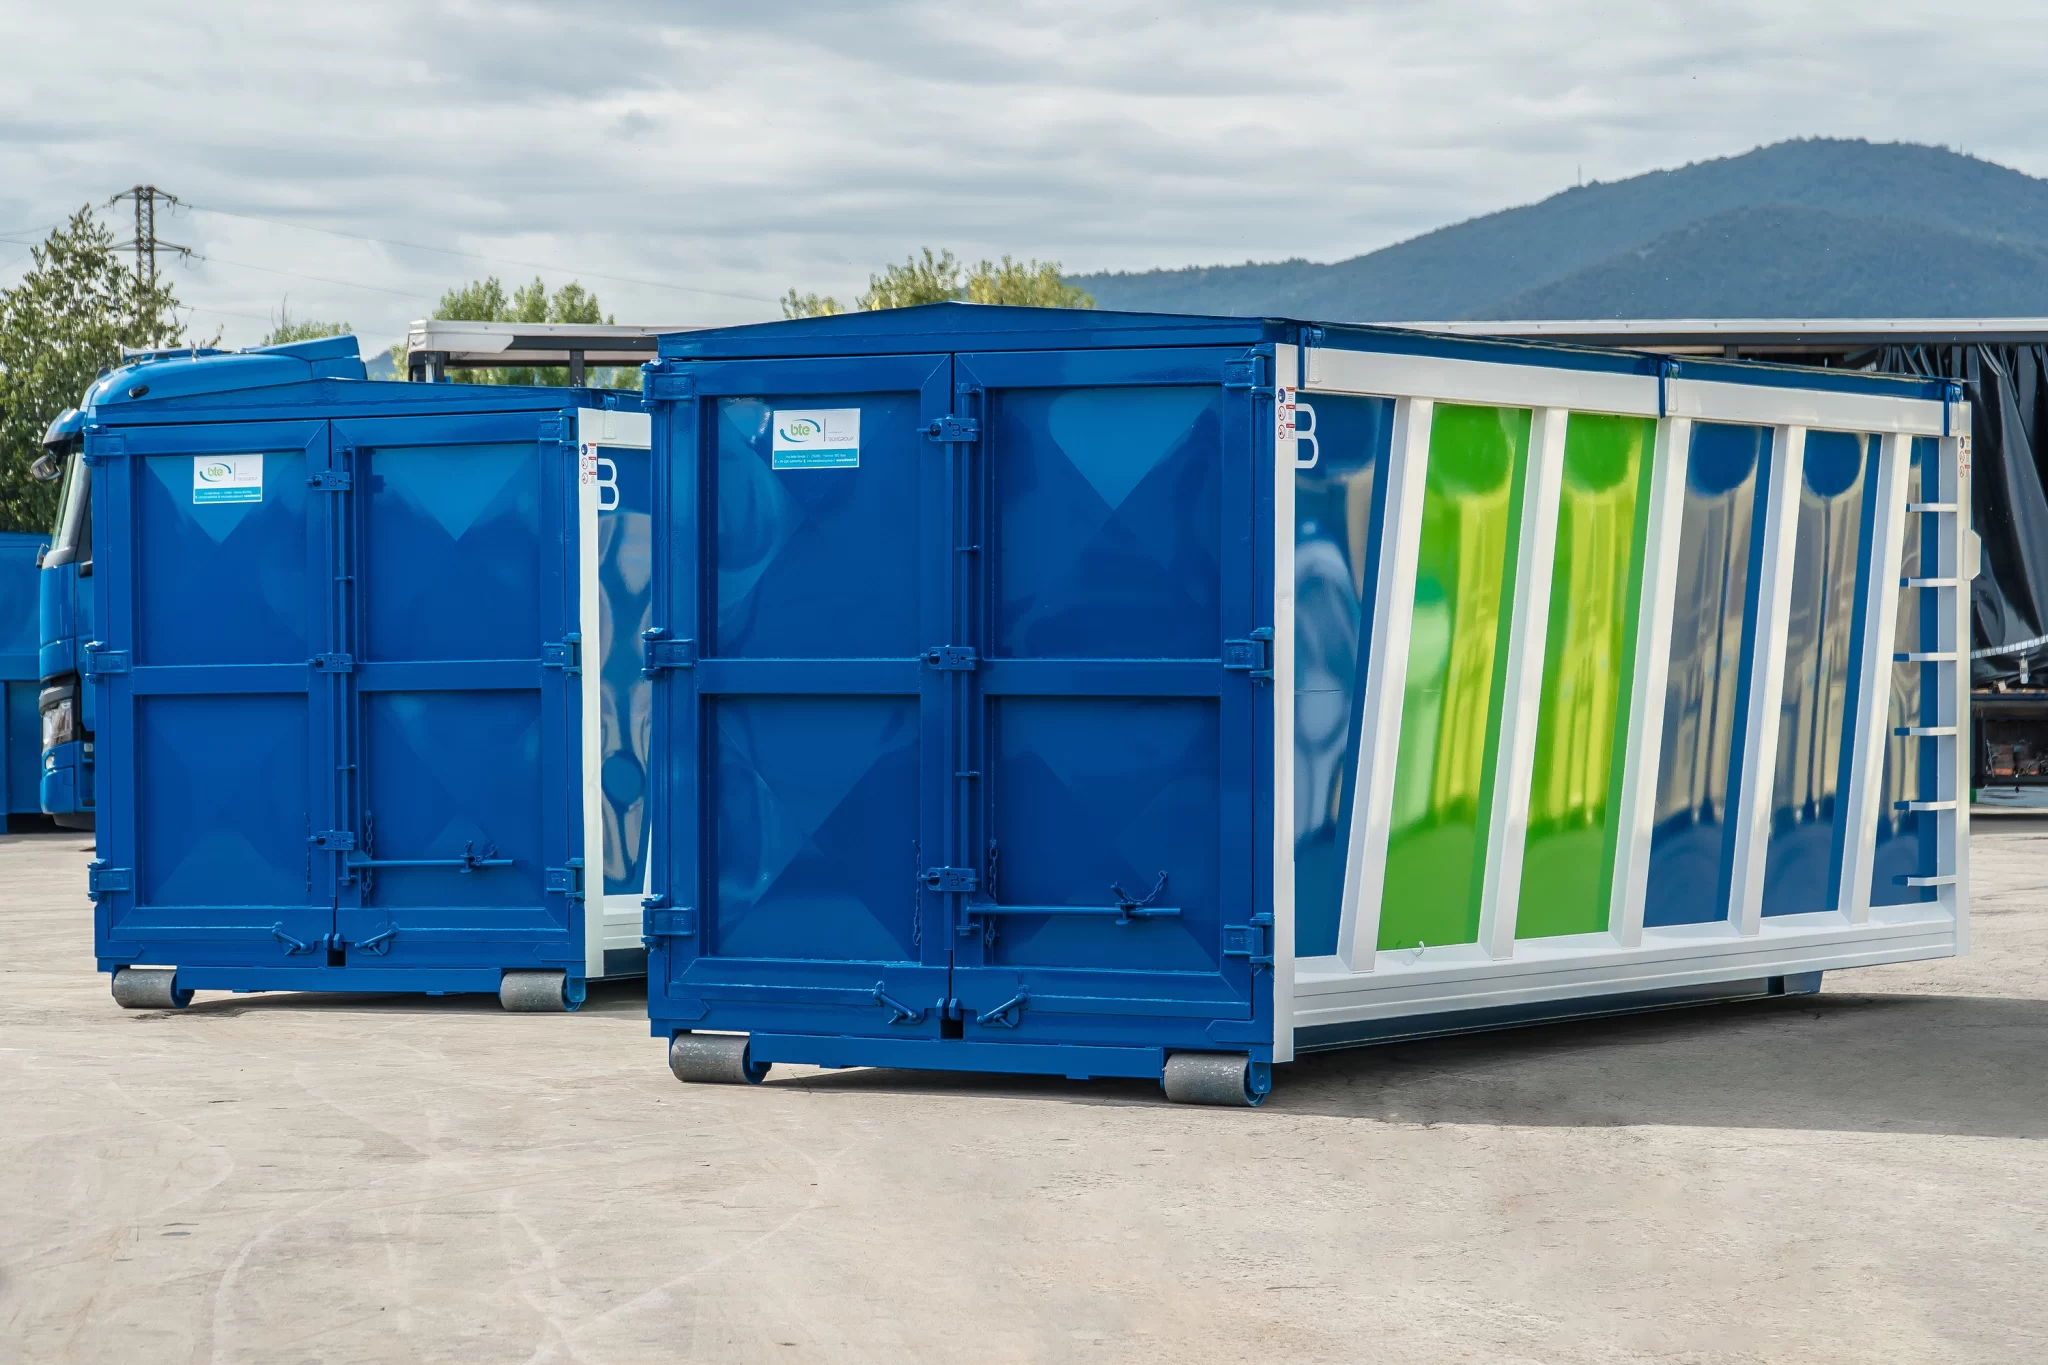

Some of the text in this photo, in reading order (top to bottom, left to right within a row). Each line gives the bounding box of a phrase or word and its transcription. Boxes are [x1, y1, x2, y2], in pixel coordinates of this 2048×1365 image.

[790, 423, 811, 436] bte
[1295, 403, 1319, 469] B
[207, 466, 224, 477] bte
[597, 457, 620, 511] B
